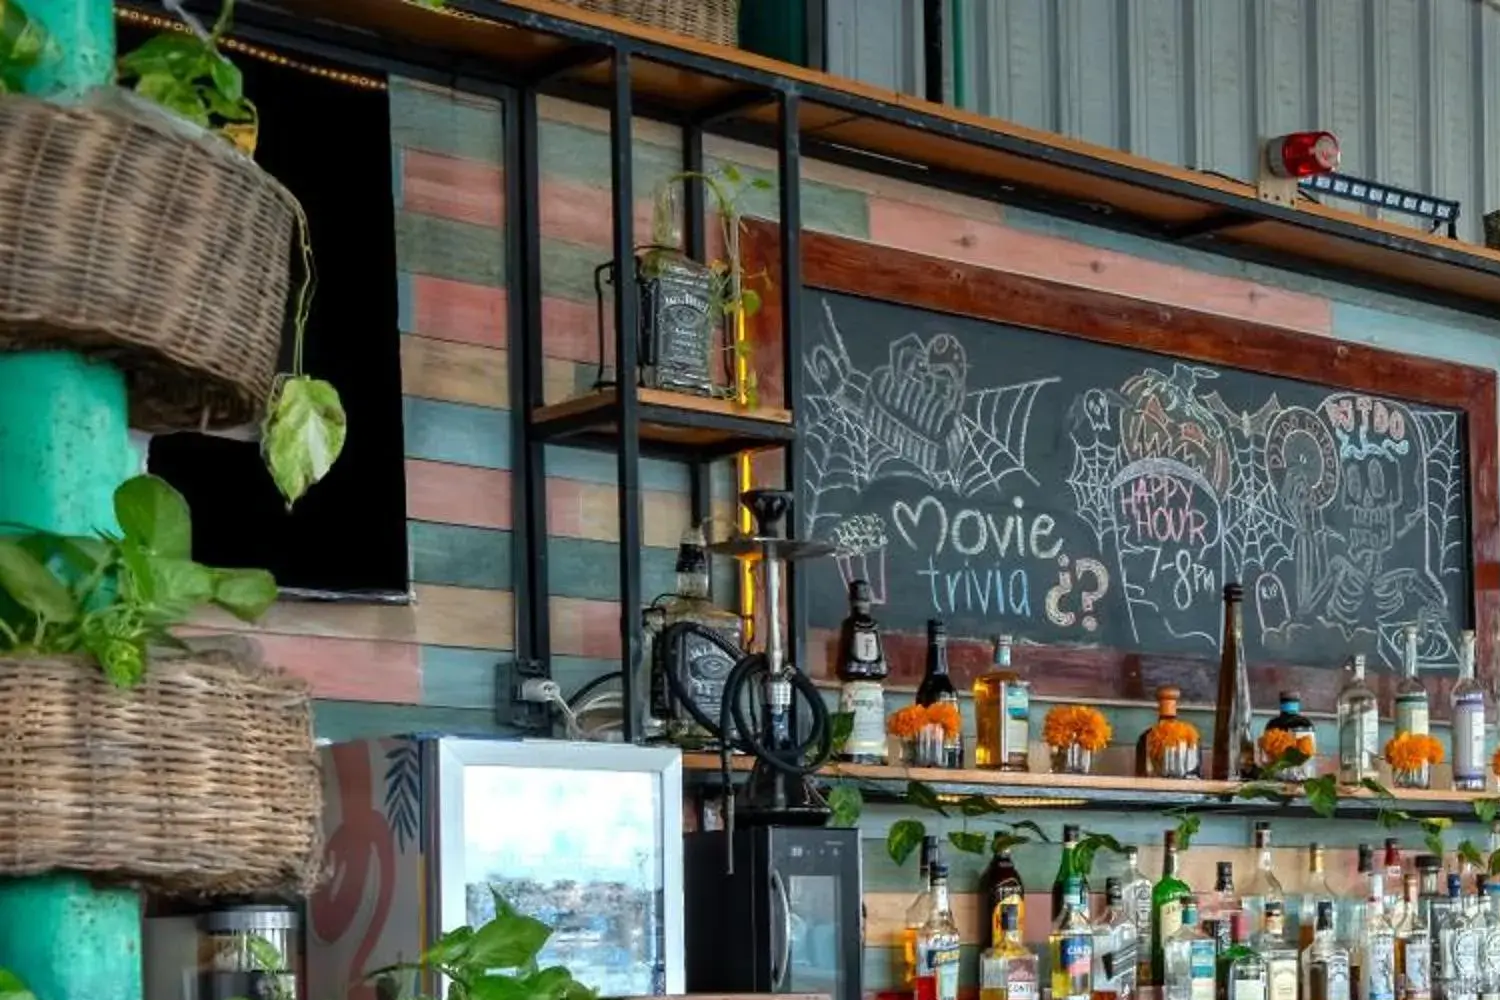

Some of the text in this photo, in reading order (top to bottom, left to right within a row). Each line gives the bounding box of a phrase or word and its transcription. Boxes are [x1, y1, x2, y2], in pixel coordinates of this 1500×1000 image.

[1120, 473, 1194, 515] HAPPY
[892, 496, 1064, 559] Movie
[1137, 506, 1208, 546] HOUR
[916, 554, 1031, 617] trivia
